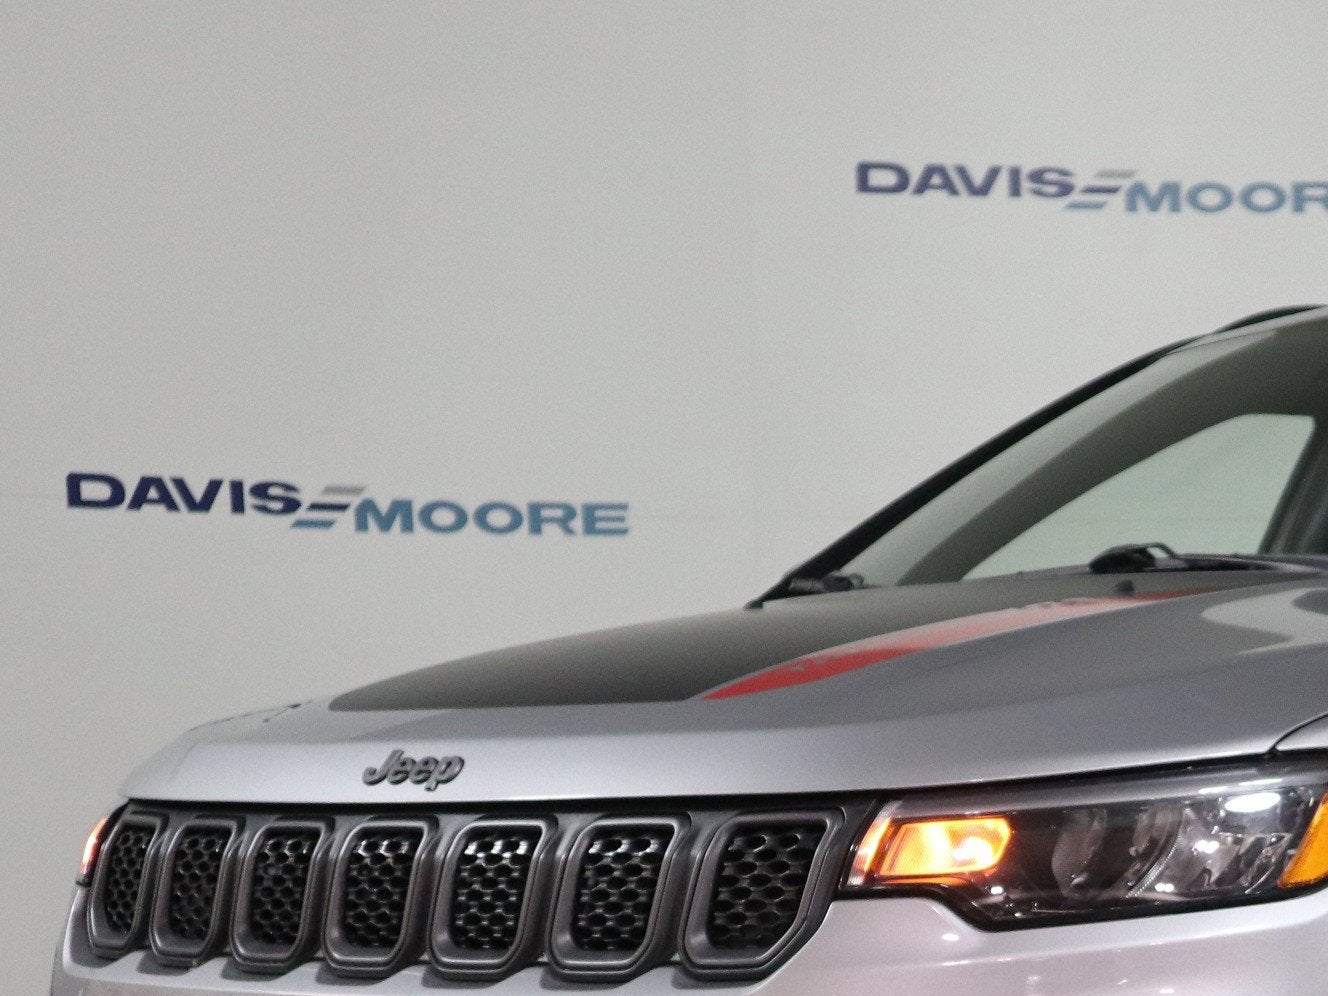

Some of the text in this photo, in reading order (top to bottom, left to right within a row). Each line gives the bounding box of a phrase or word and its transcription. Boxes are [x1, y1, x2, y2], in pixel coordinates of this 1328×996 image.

[855, 160, 1076, 199] DAVIS
[65, 472, 630, 536] DAVIS MOORE
[362, 749, 465, 792] Jeep
